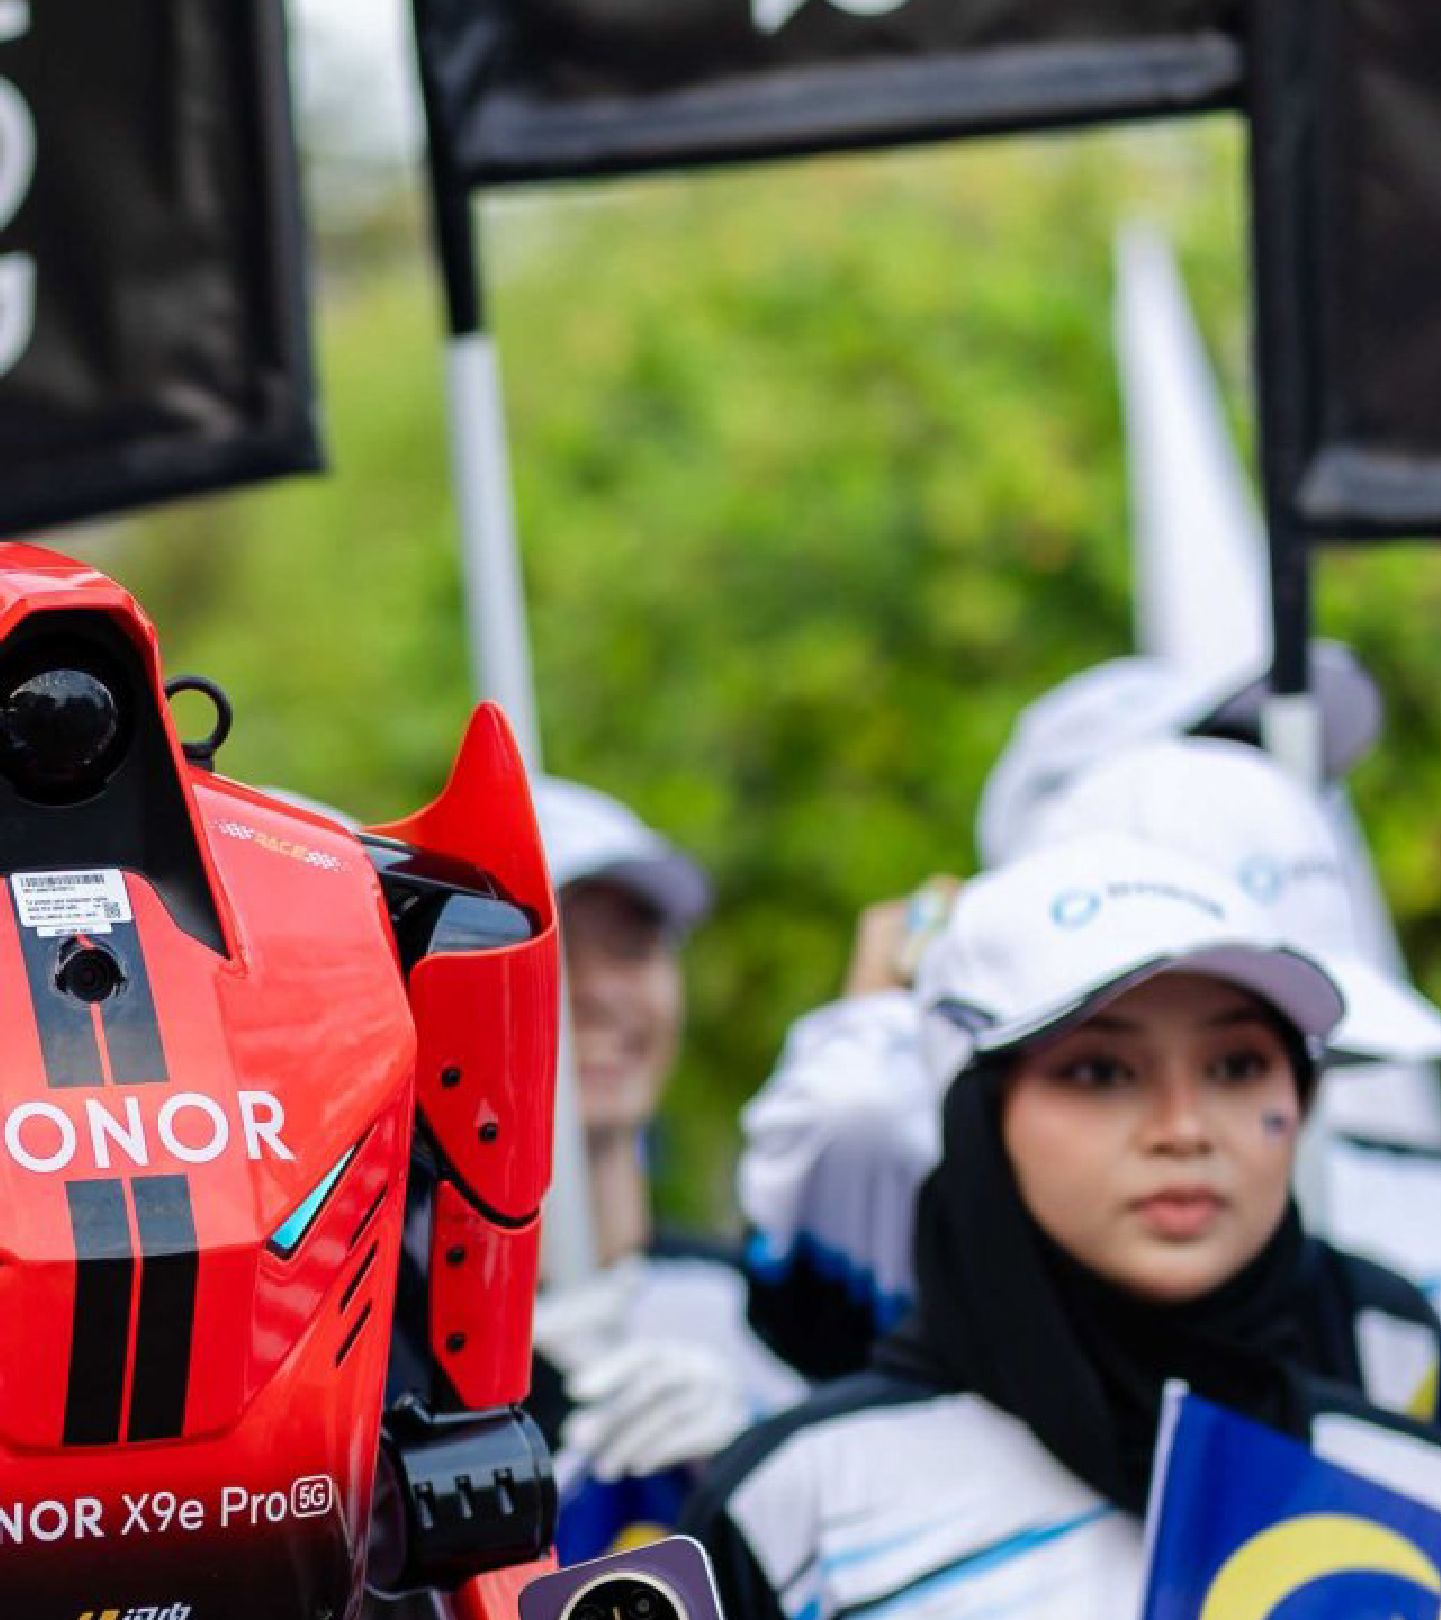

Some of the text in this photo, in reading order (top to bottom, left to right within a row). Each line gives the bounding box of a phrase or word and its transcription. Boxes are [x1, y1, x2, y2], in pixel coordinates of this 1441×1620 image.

[120, 1491, 205, 1537] X9e
[220, 1486, 288, 1528] Pro
[294, 1478, 330, 1513] 5G
